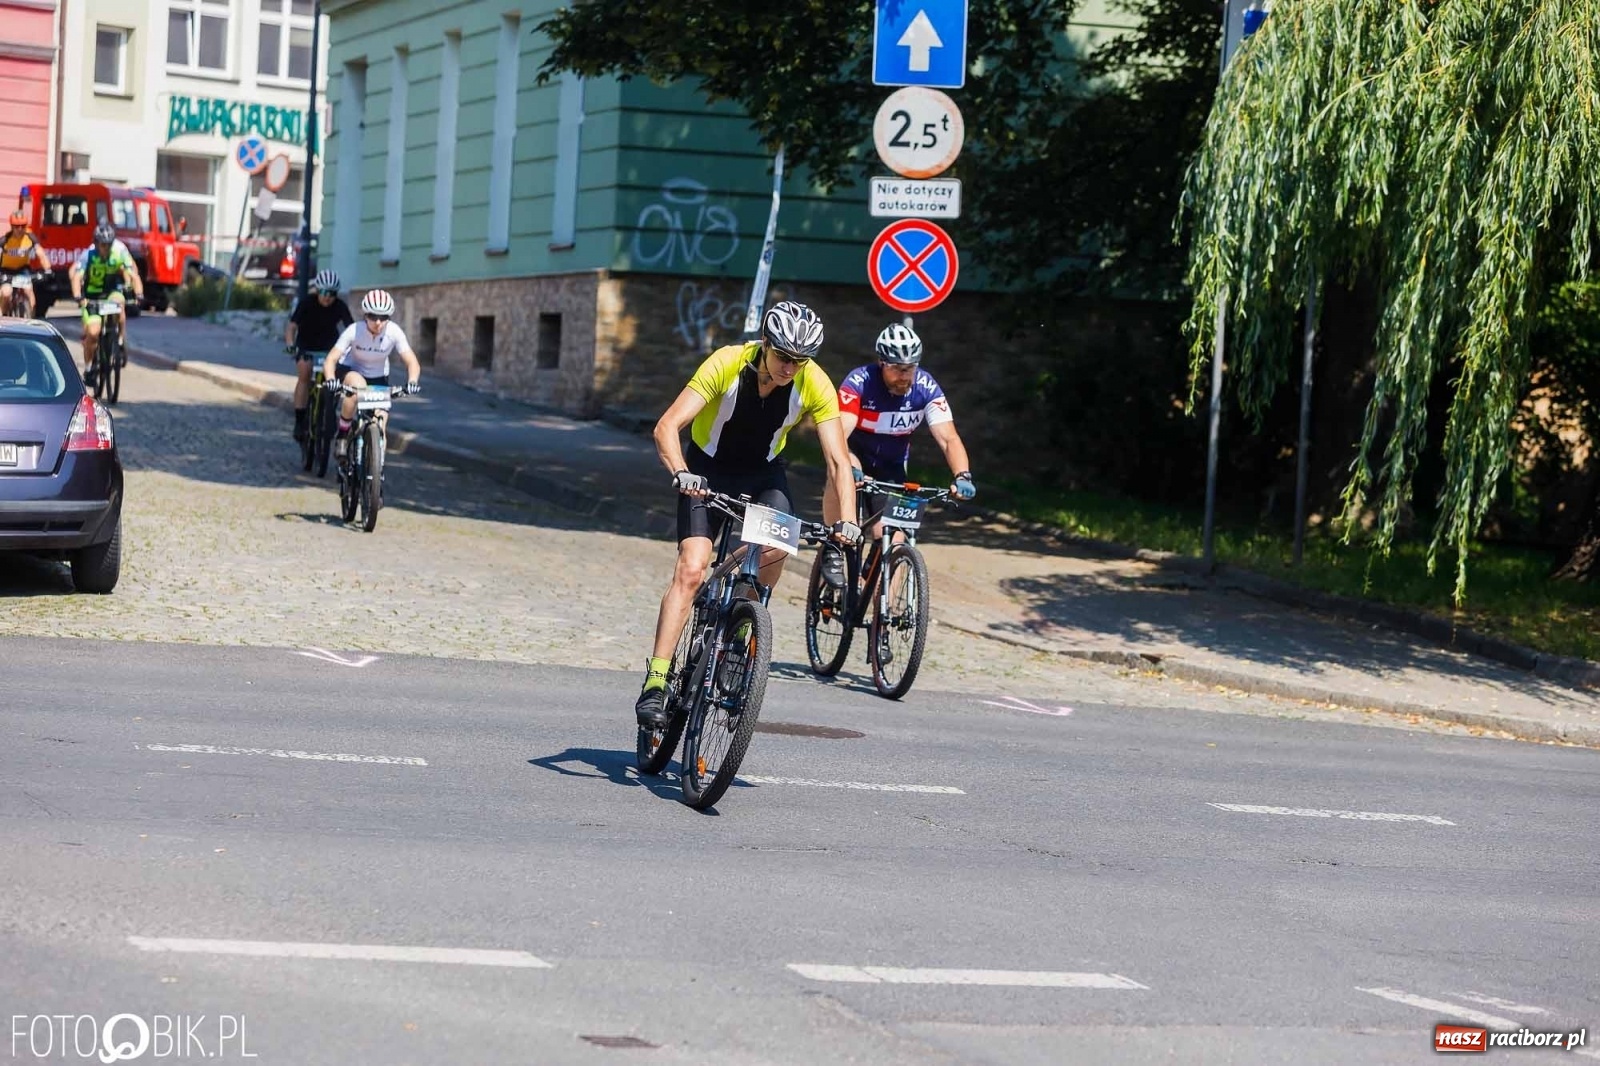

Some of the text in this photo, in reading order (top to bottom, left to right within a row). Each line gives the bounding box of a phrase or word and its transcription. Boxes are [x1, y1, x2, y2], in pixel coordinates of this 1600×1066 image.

[877, 184, 953, 198] Nie dotyczy
[878, 201, 947, 211] autokarów
[916, 371, 938, 395] IAM
[890, 413, 920, 428] IAM
[891, 505, 918, 520] 1324
[755, 517, 790, 540] 1656
